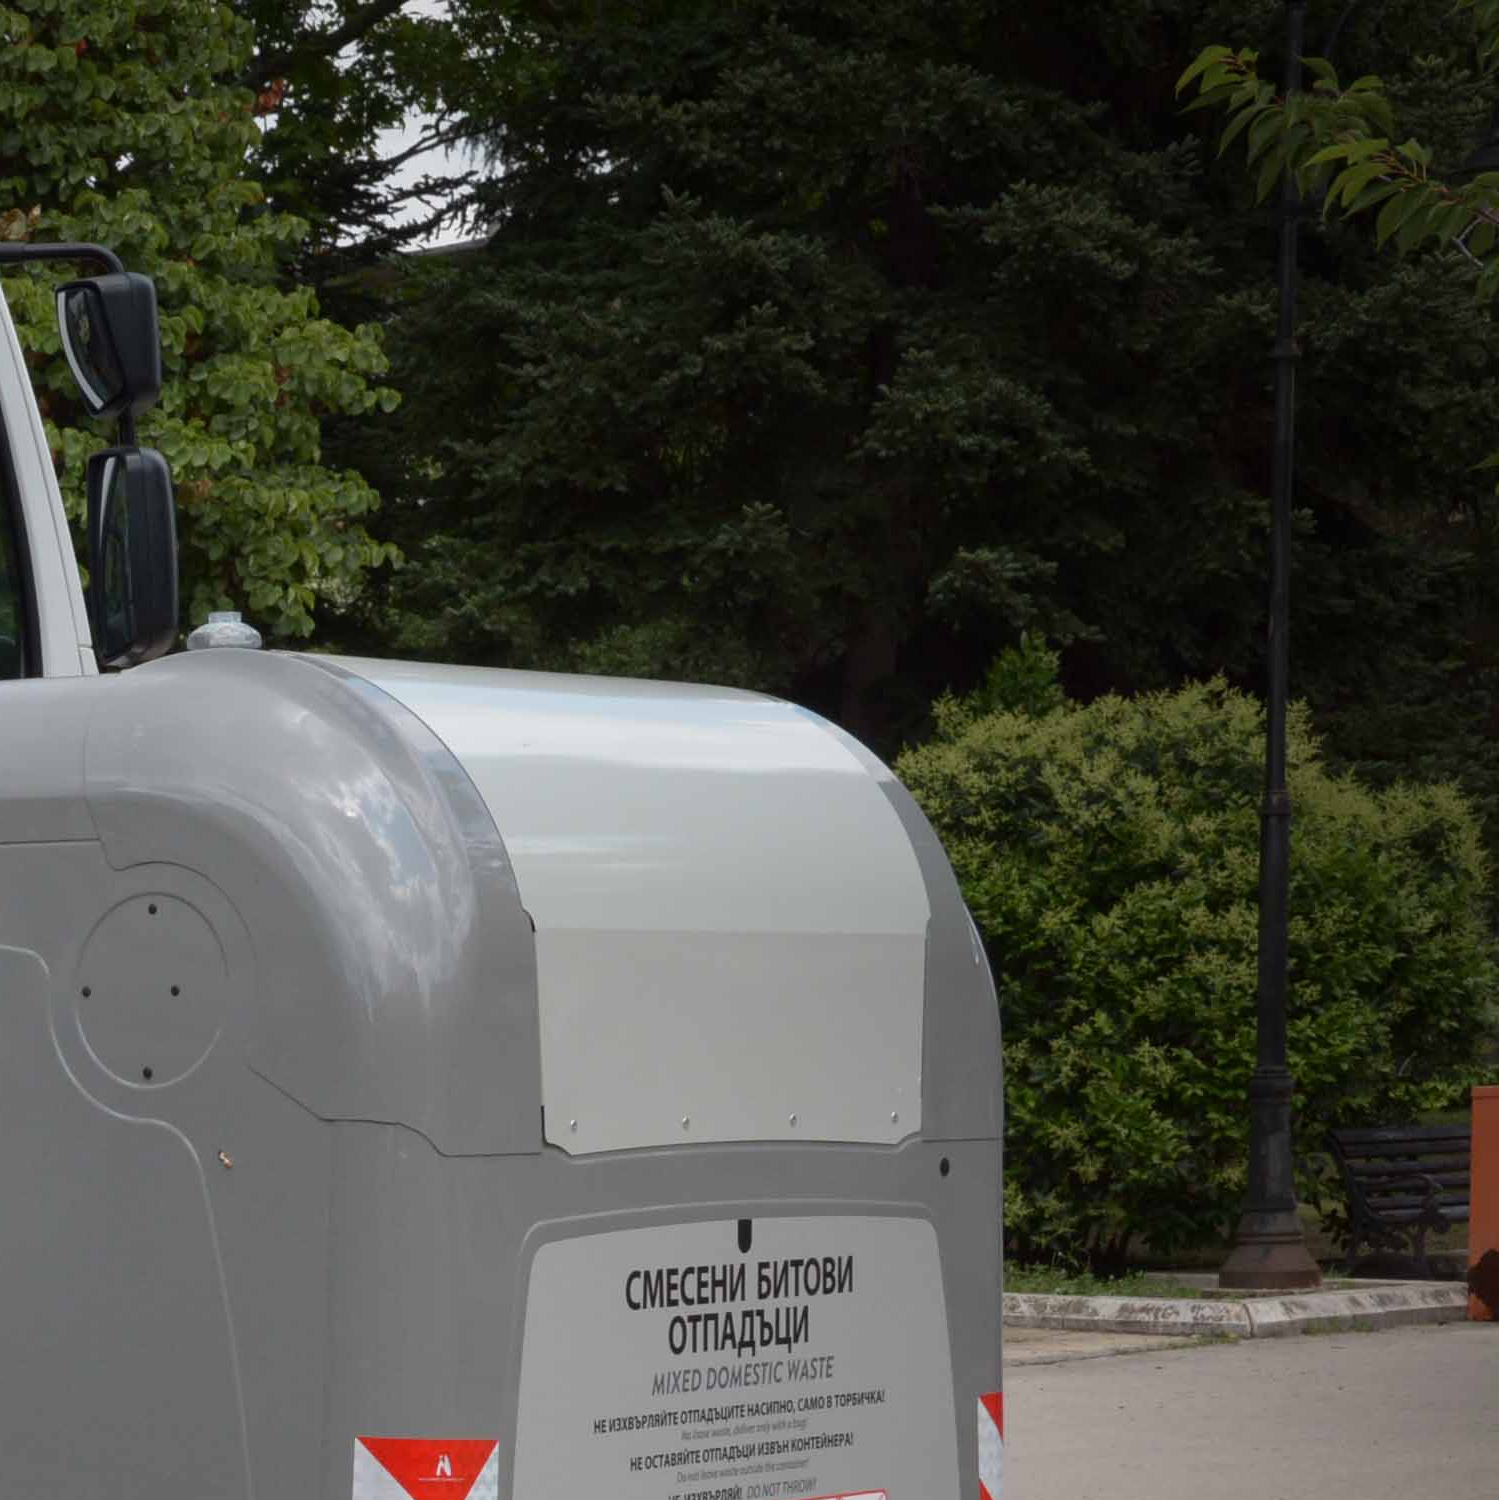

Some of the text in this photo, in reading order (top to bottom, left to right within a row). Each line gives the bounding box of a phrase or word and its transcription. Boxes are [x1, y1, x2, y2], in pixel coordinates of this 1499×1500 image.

[626, 1256, 852, 1310] СМЕСЕНИ БИТОВИ
[669, 1306, 808, 1357] ОТПАДЪЦИ
[652, 1356, 834, 1395] MIXED DOMESTIC WASTE
